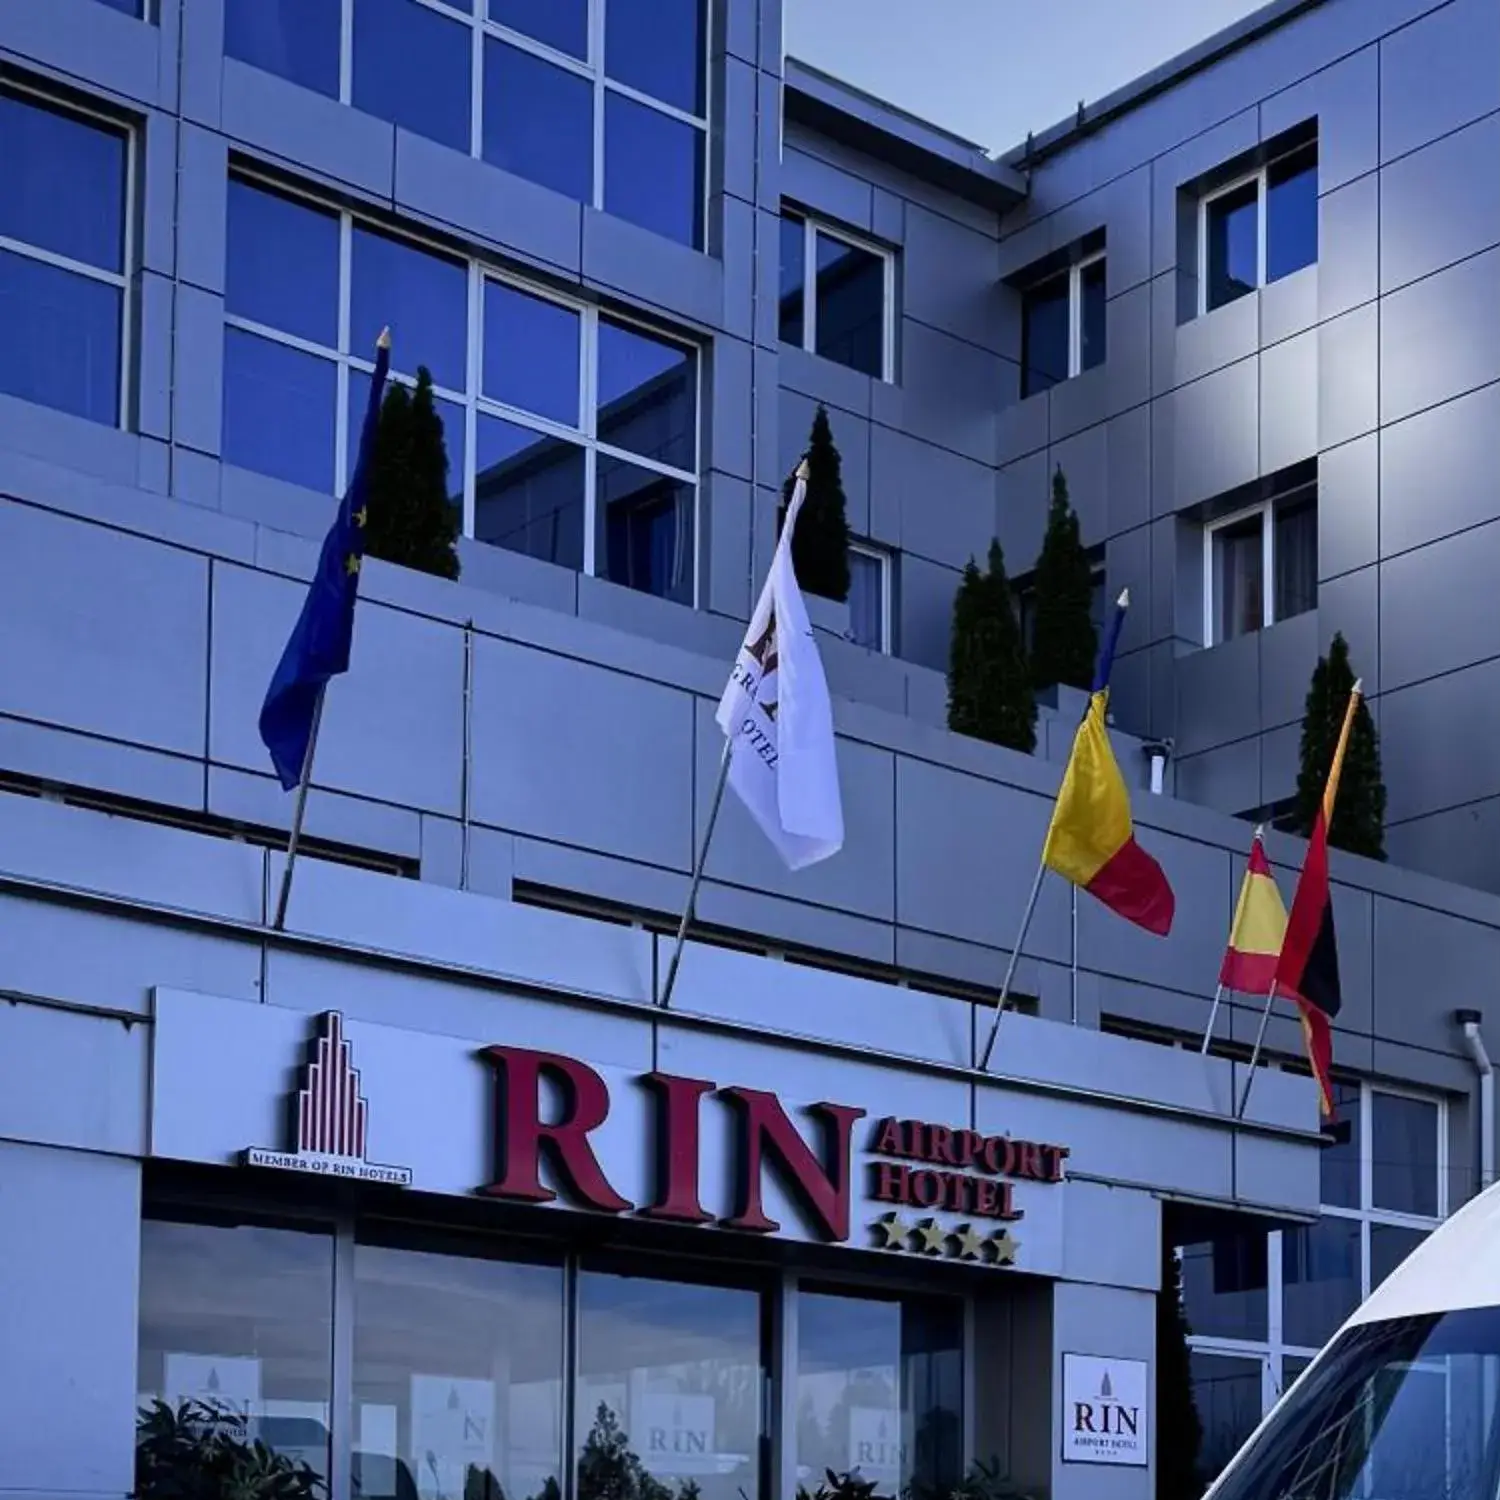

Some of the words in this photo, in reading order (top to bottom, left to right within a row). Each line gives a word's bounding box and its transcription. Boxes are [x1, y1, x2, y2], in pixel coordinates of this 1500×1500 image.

[475, 1045, 867, 1243] RIN
[876, 1116, 1070, 1183] AIRPORT
[252, 1153, 307, 1168] MEMBER
[311, 1160, 328, 1173] OF
[333, 1165, 355, 1176] RIN
[359, 1168, 407, 1182] HOTELS
[878, 1163, 1025, 1219] HOTEL
[648, 1427, 707, 1454] RIN
[1074, 1402, 1139, 1436] RIN
